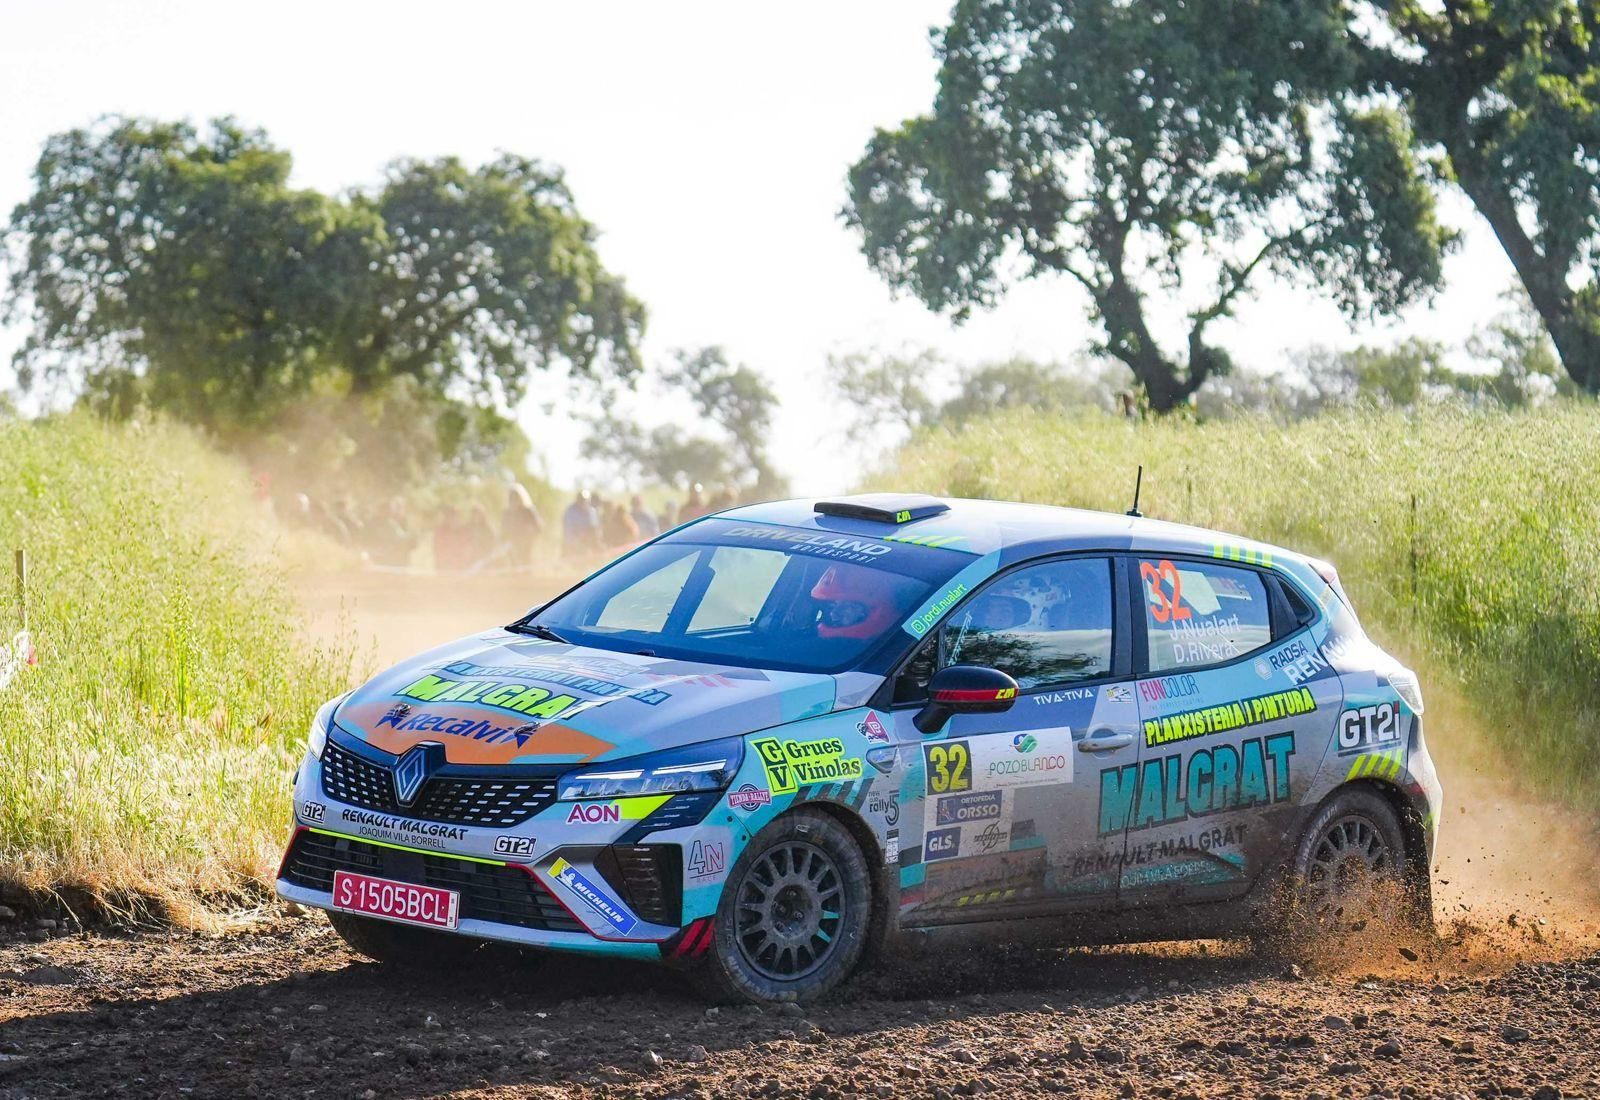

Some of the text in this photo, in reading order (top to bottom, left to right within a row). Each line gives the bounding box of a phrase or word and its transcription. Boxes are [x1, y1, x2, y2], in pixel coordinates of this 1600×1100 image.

[723, 527, 892, 556] DRIVELAND
[789, 544, 877, 564] MOTORSPORT
[1141, 560, 1192, 623] 32
[919, 584, 967, 628] jordi.nualart
[1169, 614, 1240, 641] J.Nualart
[1173, 642, 1234, 664] D.Rivera
[1269, 640, 1308, 670] RADSA
[393, 674, 606, 720] MALGRAT
[1034, 690, 1094, 705] TIVA-TIVA
[1140, 674, 1200, 702] FUNCOLOR
[397, 713, 513, 744] Recalvi
[1145, 708, 1245, 745] PLANXISTERIA
[1252, 688, 1315, 722] PINTURA
[1339, 701, 1400, 748] GT2i
[786, 739, 843, 759] Grues
[793, 759, 861, 781] Viñolas
[929, 744, 968, 792] 32
[989, 755, 1066, 776] POZOBLANCO
[1098, 731, 1296, 838] MALGRAT
[957, 804, 999, 819] ORSSO
[961, 794, 996, 804] ORTOPEDIA
[342, 808, 469, 841] RENAULT MALGRAT
[567, 804, 620, 823] AON
[358, 825, 446, 849] JOAQUIM VILA BORRELL
[496, 837, 536, 856] GT2i
[1157, 823, 1248, 859] MALGRAT
[574, 882, 624, 924] MICHELIN
